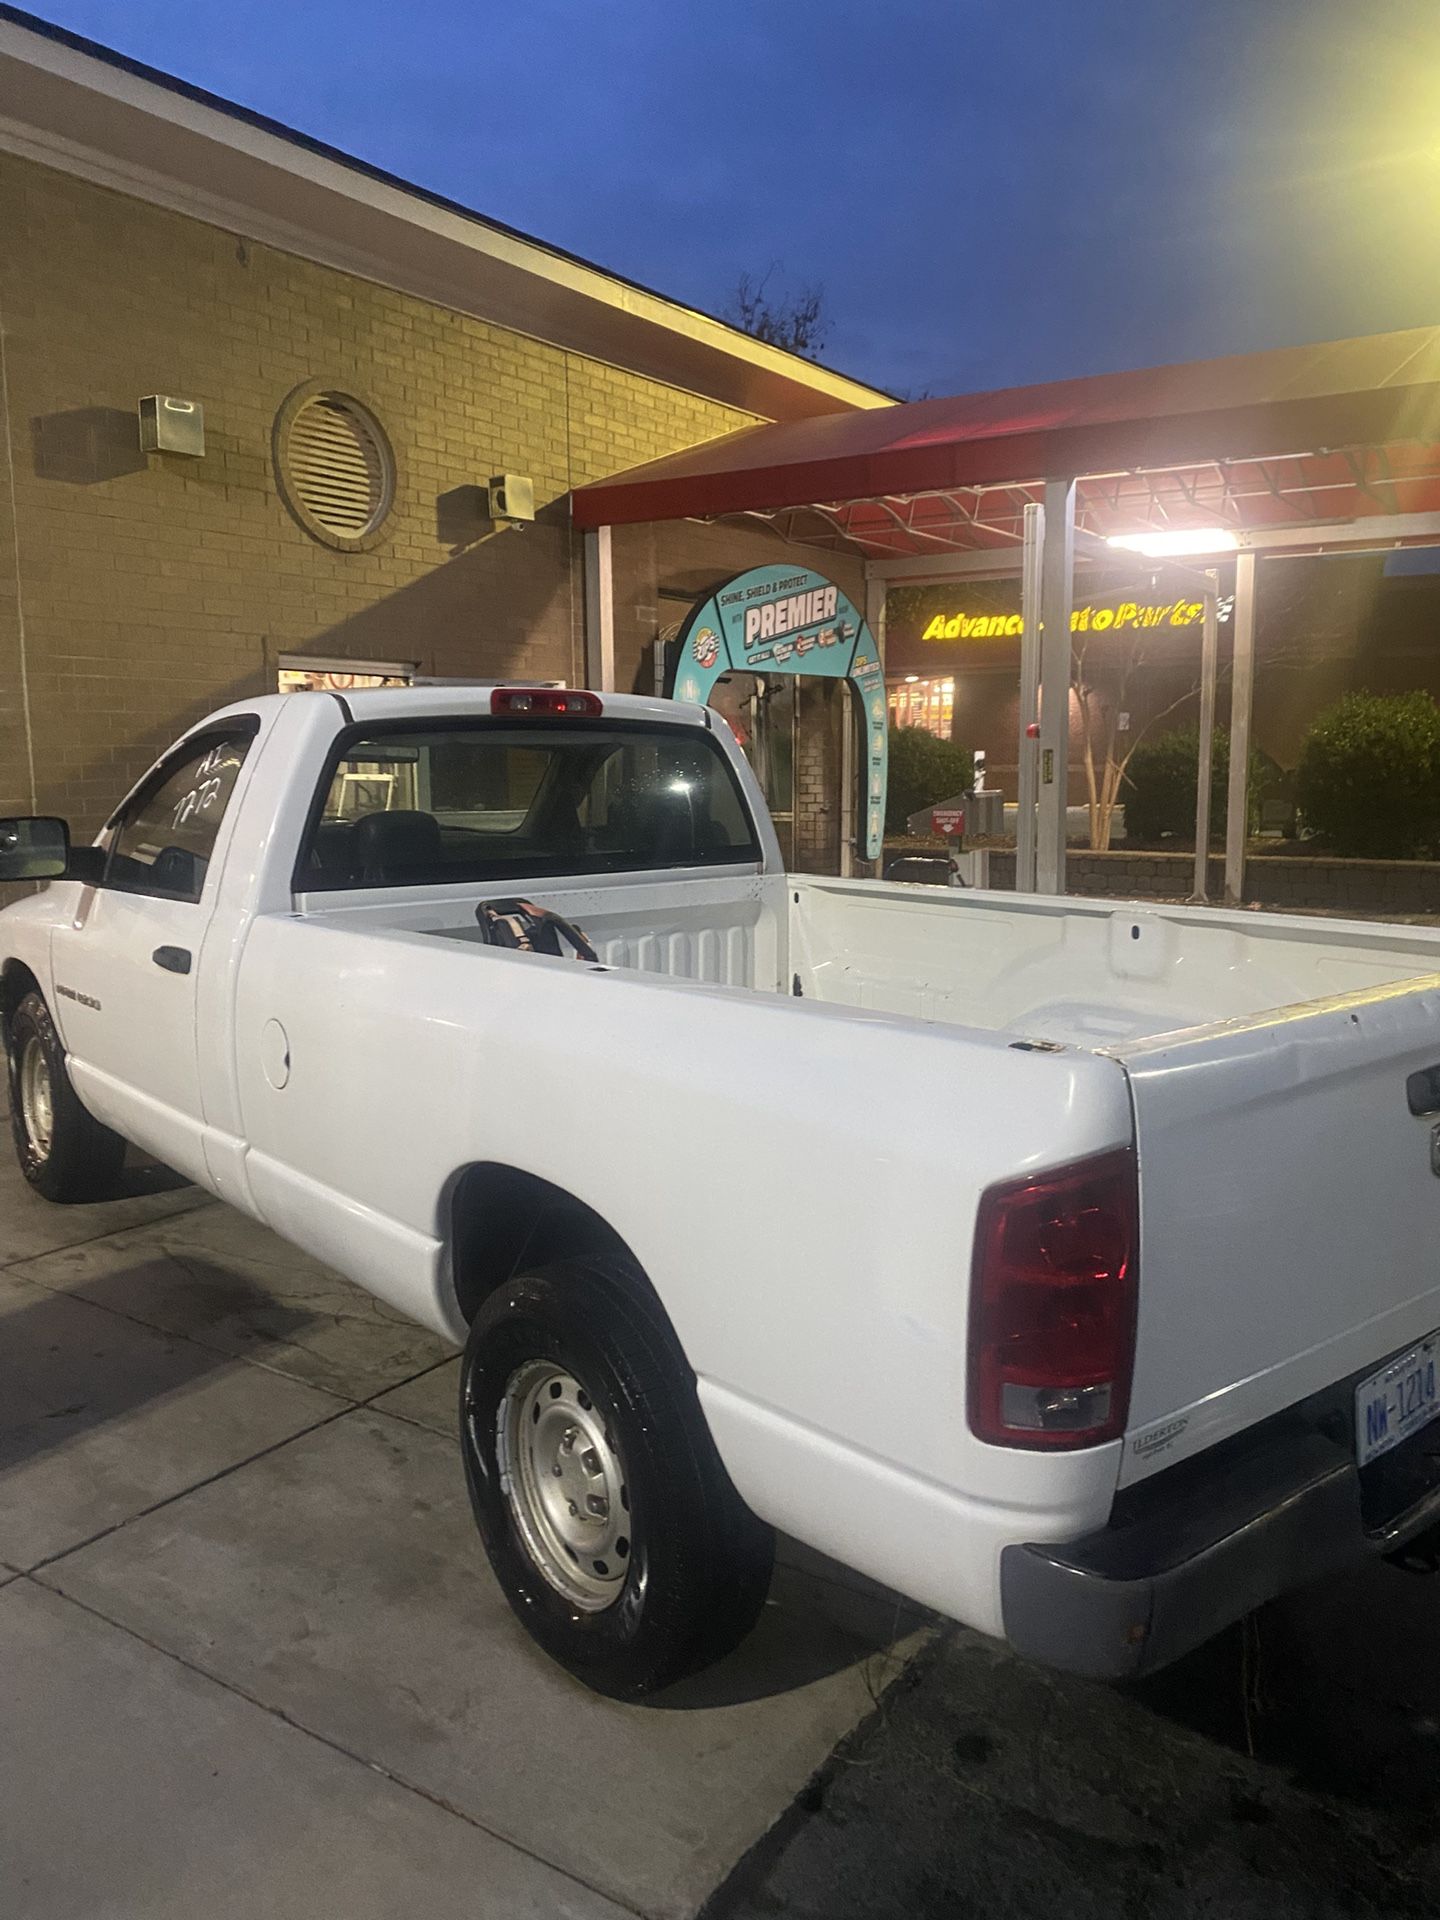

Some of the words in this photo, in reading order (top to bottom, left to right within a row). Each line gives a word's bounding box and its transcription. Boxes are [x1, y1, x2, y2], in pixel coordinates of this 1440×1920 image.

[746, 585, 771, 600] SHIELD
[772, 582, 778, 593] &
[779, 575, 808, 591] PROTECT
[745, 585, 838, 648] PREMIER
[922, 612, 1043, 640] Advanc
